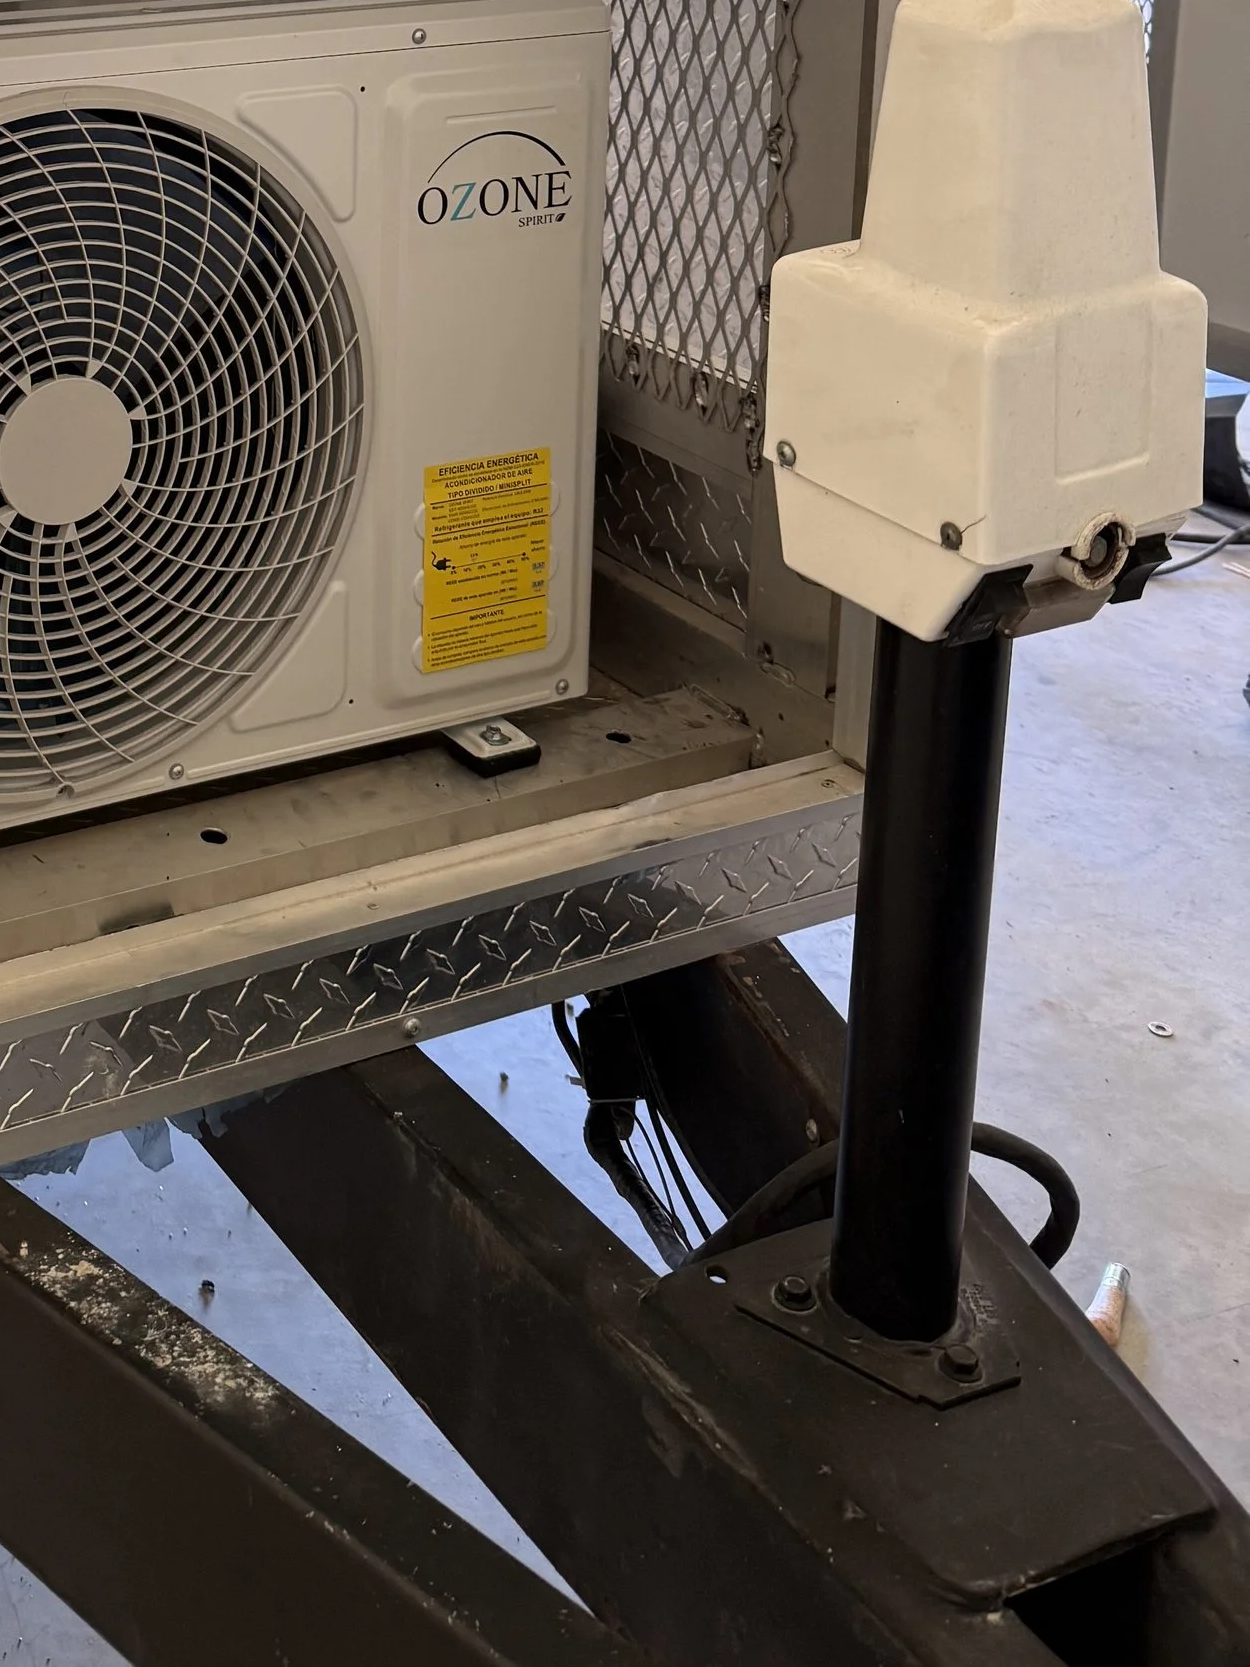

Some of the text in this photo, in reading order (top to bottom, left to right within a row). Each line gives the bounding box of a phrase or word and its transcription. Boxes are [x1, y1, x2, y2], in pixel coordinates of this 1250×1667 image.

[417, 170, 572, 225] OZONE
[518, 214, 555, 227] SPIRIT
[439, 462, 485, 476] EFICIENCIA
[486, 452, 539, 468] ENERGÉTICA
[444, 473, 506, 488] ACONDICIONADOR
[517, 468, 533, 476] AIRE
[465, 486, 495, 495] DIVIDIDO
[499, 479, 531, 489] MINISPLIT
[434, 521, 470, 533] Refrigerante
[482, 515, 503, 524] emplea
[469, 609, 505, 621] IMPORTANTE
